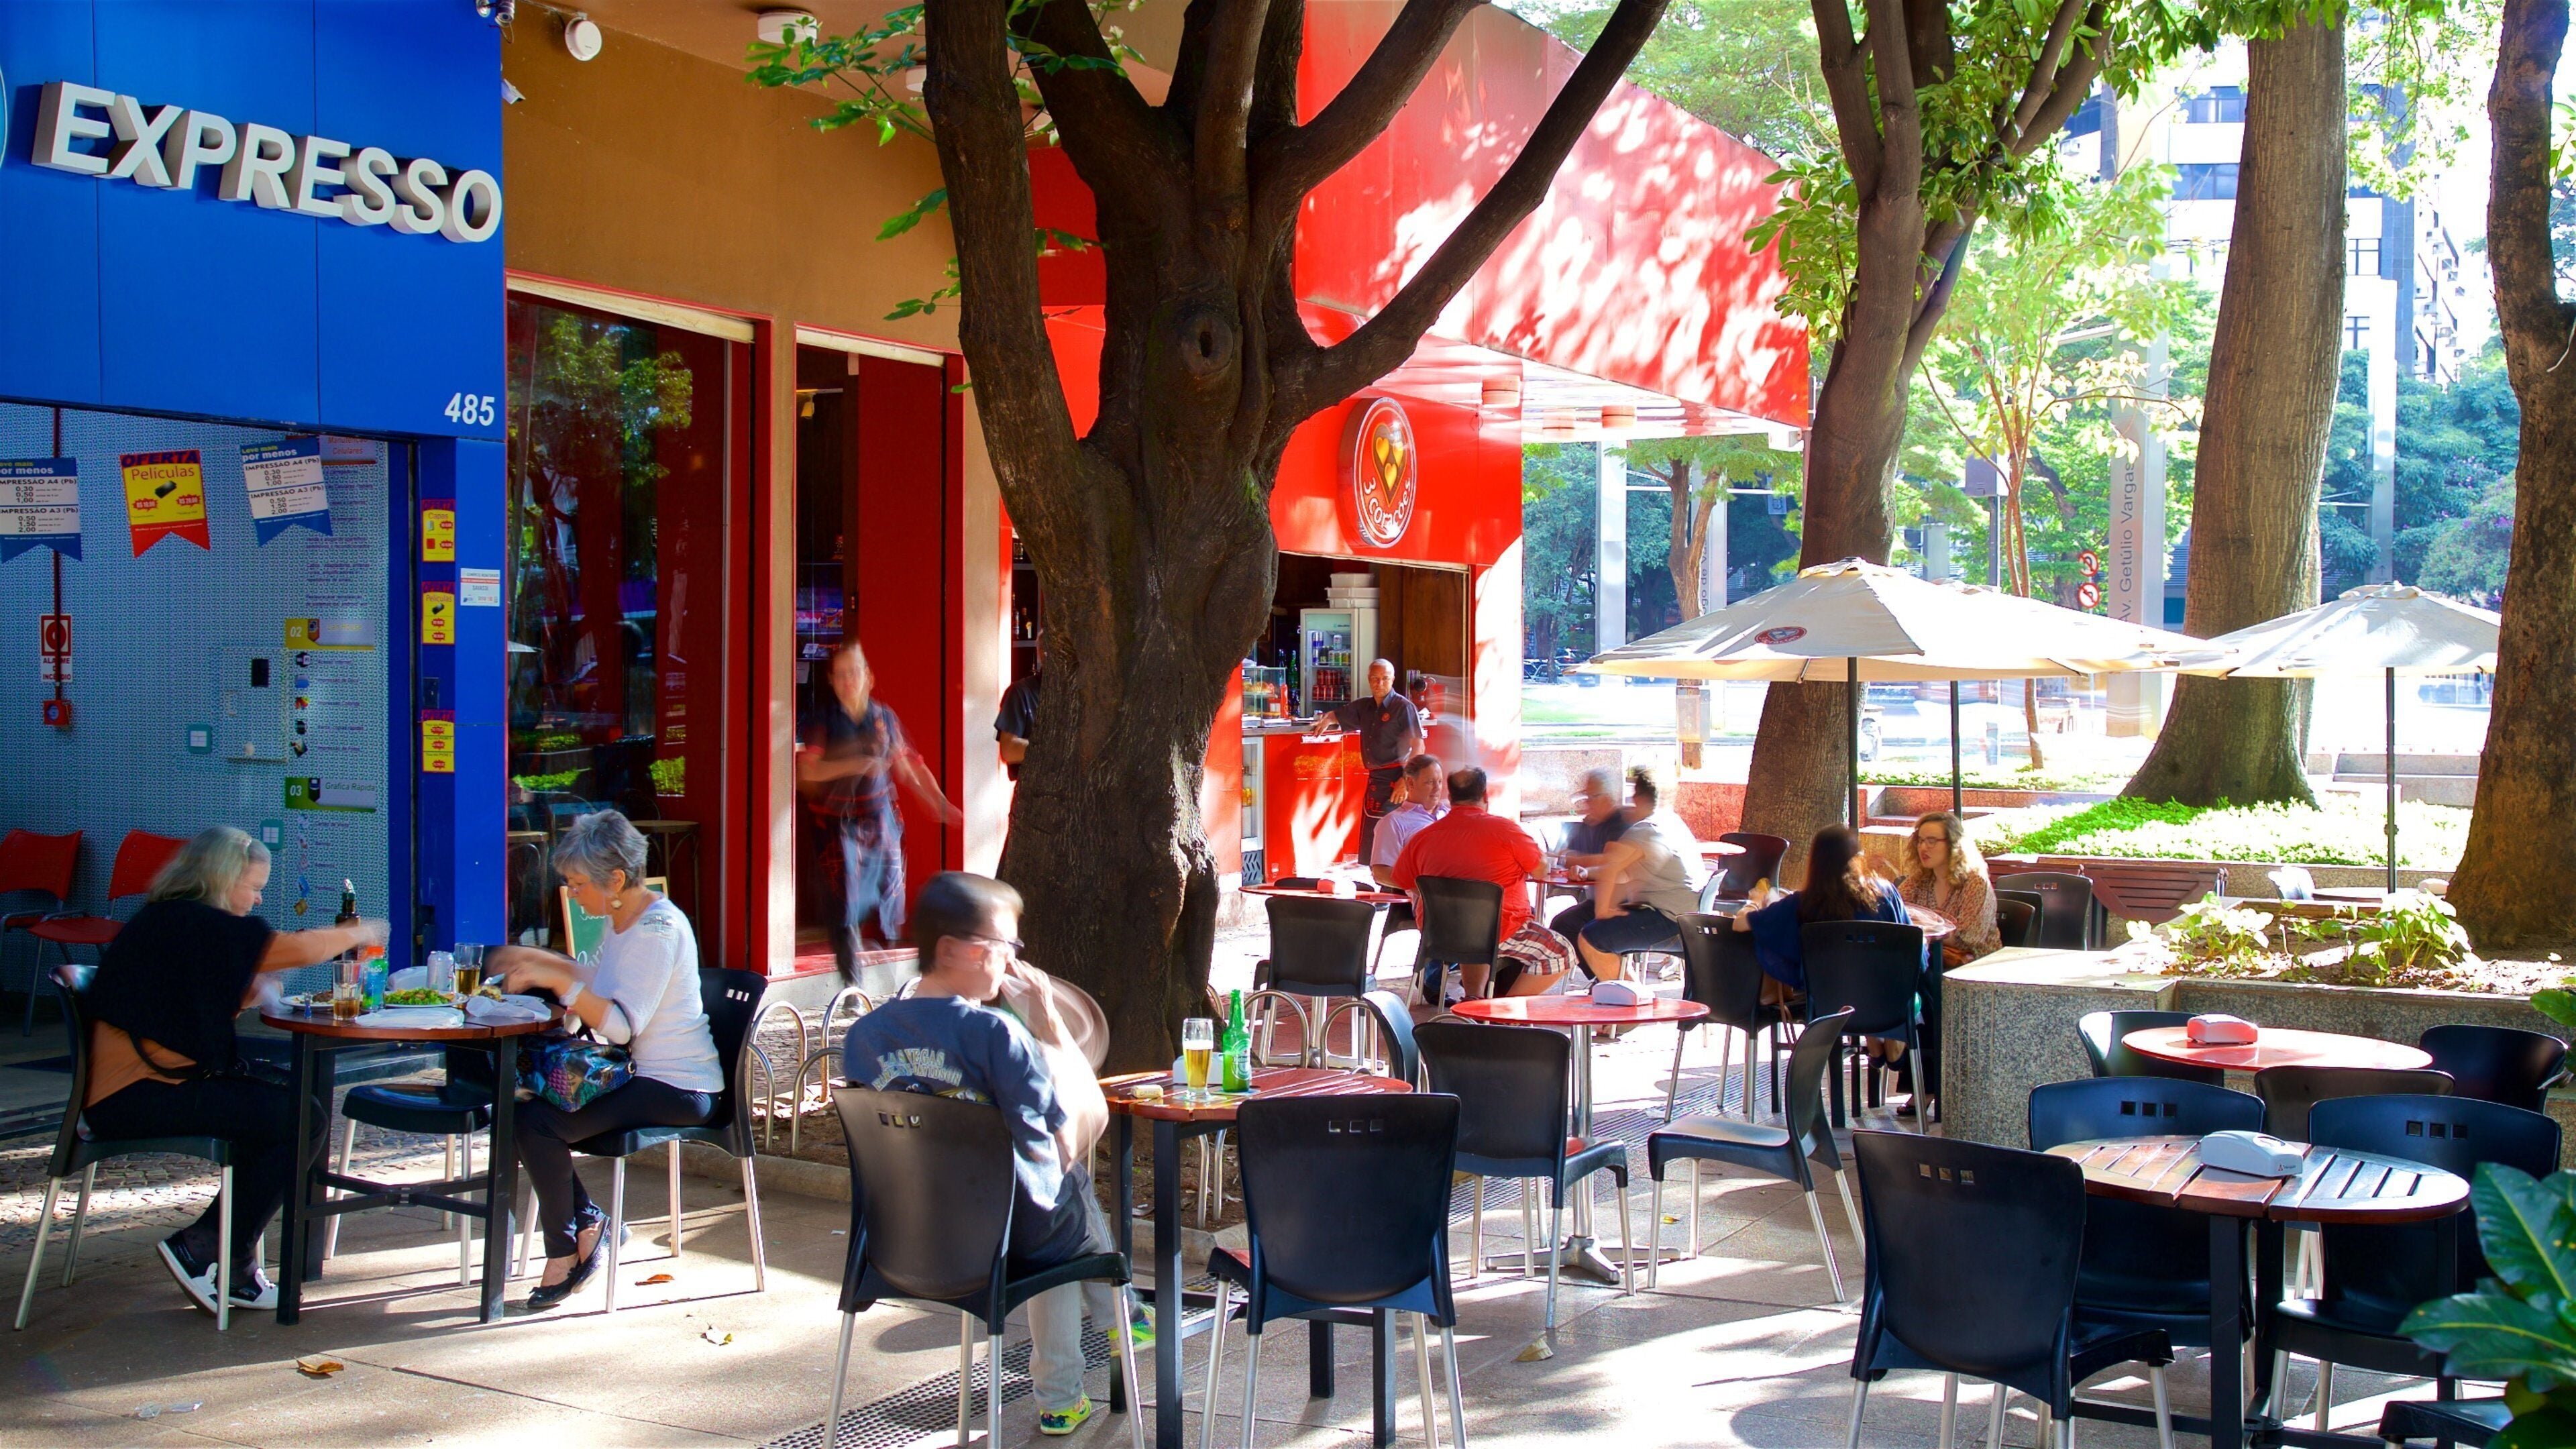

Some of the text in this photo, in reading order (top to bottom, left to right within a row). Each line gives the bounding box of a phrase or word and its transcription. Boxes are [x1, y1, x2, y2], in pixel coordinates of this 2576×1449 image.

[32, 81, 502, 243] EXPRESSO
[444, 392, 494, 426] 485
[122, 450, 199, 467] OFERTA
[242, 449, 297, 462] por menos
[131, 466, 195, 480] Películas
[1364, 477, 1376, 494] 3
[2121, 464, 2137, 524] Vargas
[2120, 529, 2133, 592] Getúlio
[1701, 568, 1707, 585] de
[290, 627, 301, 637] 02
[290, 785, 302, 796] 03
[876, 1047, 945, 1069] LAS VEGAS
